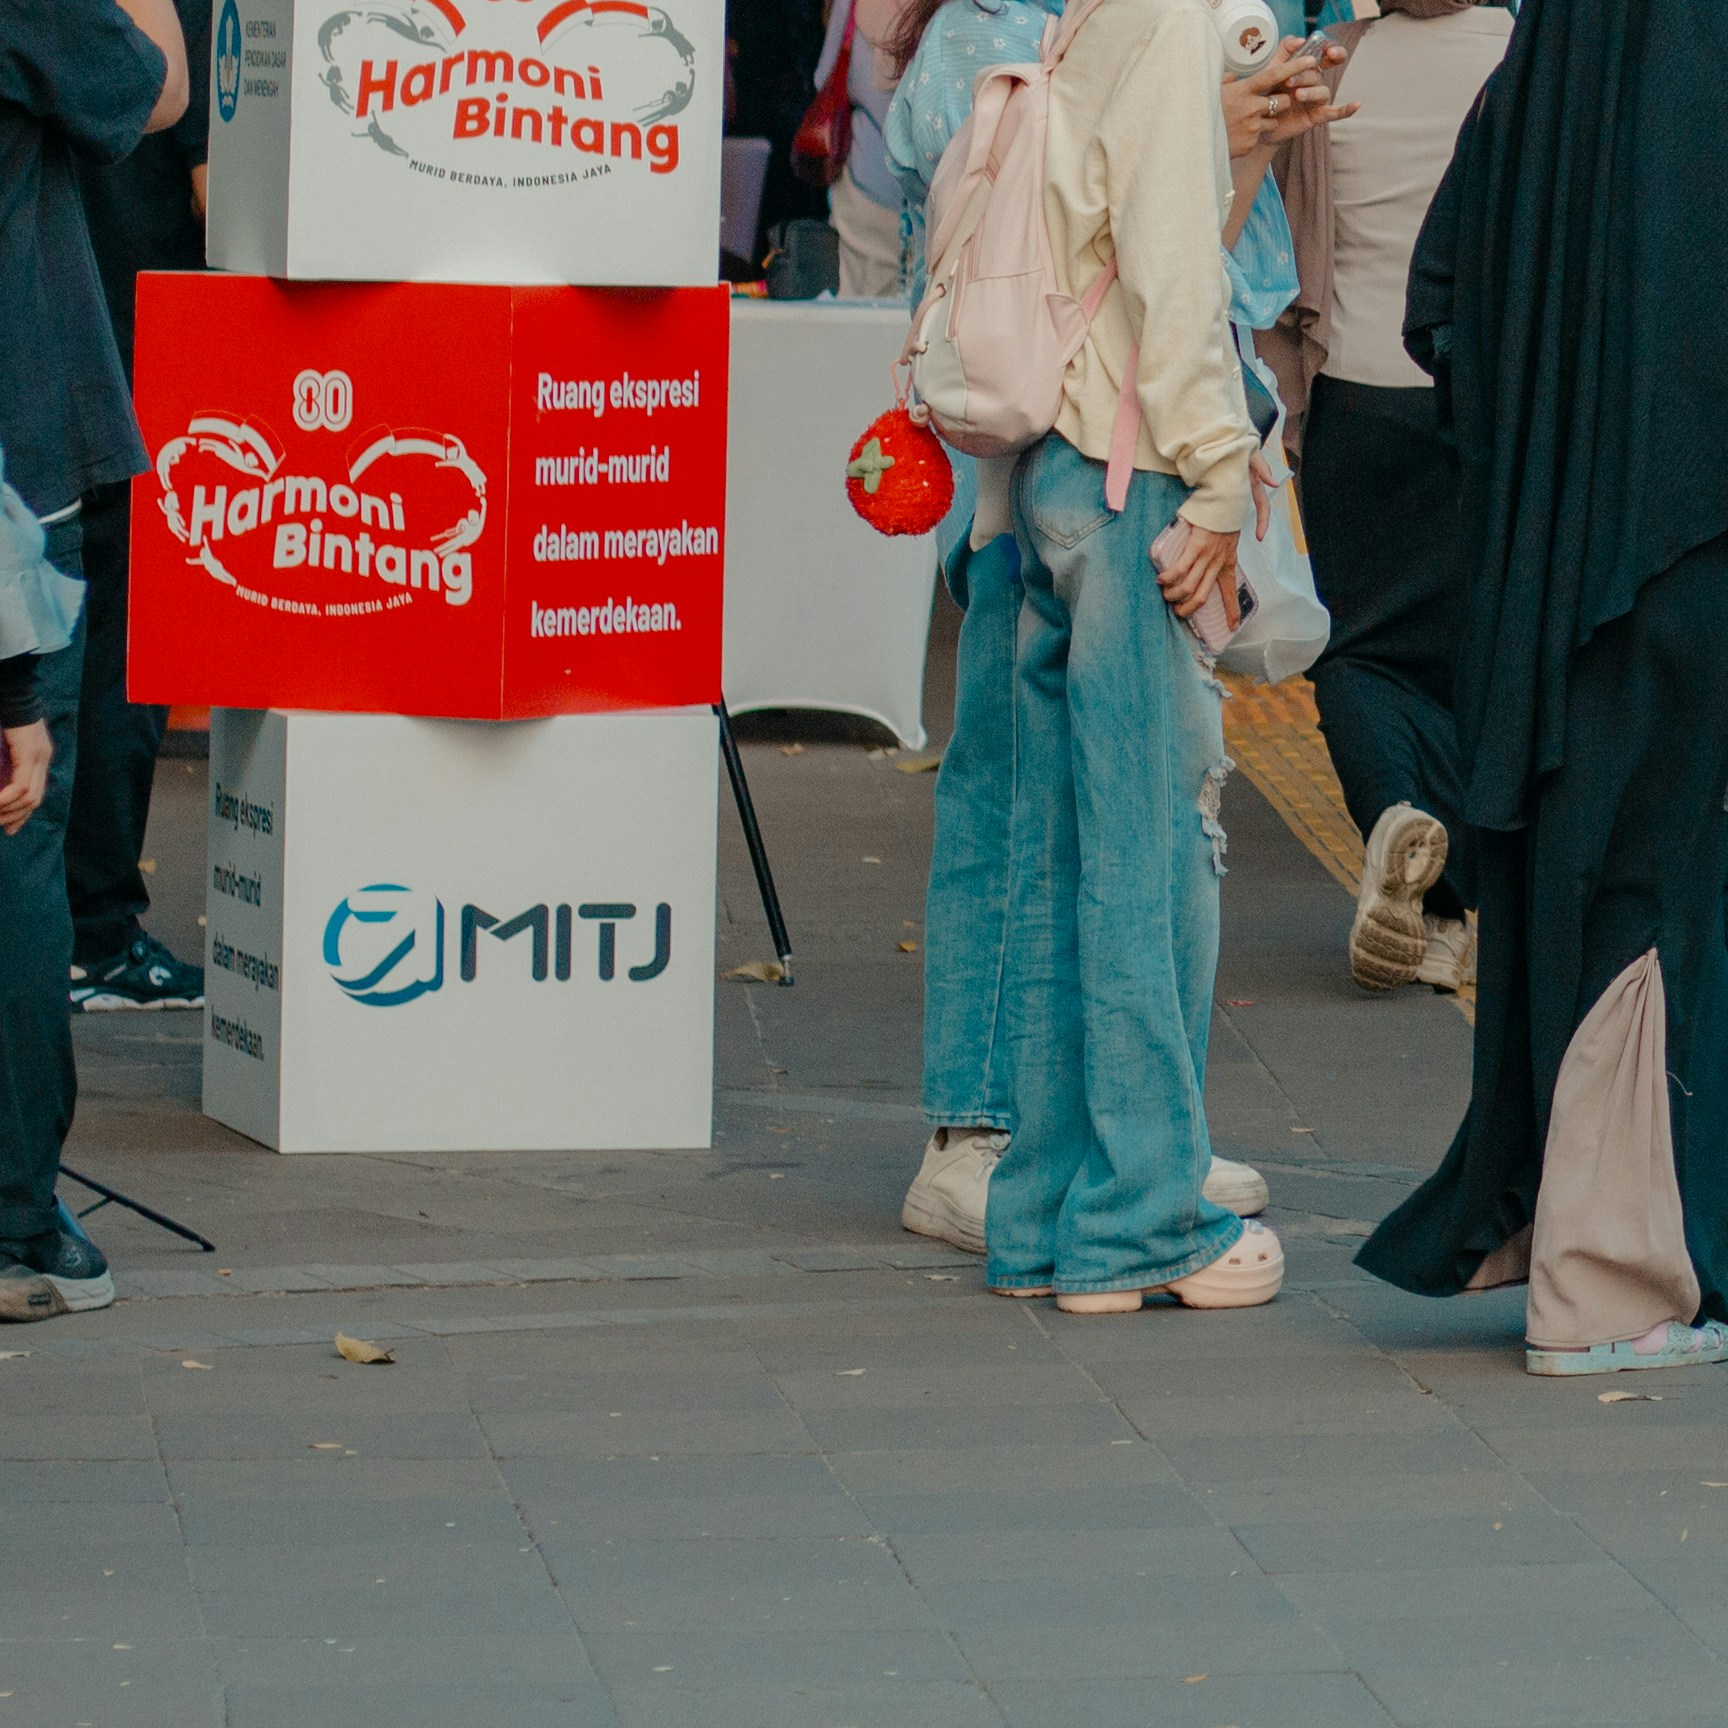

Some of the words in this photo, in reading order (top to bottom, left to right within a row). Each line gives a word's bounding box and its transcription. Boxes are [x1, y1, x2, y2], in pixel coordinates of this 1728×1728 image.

[355, 49, 603, 119] Harmoni
[453, 92, 680, 175] Bintang
[409, 158, 445, 178] MURID
[450, 171, 507, 188] BERDAYA,
[513, 173, 578, 188] INDONESIA
[583, 164, 612, 180] JAYA
[292, 369, 353, 432] 80
[537, 372, 605, 418] Ruang
[610, 369, 700, 417] ekspresi
[535, 444, 670, 486] murid-murid
[189, 475, 405, 546] Harmoni
[273, 519, 472, 606] Bintang
[533, 523, 599, 562] dalam
[604, 519, 719, 566] merayakan
[236, 584, 268, 607] MURID
[325, 598, 383, 616] INDONESIA
[386, 591, 413, 609] JAYA
[530, 595, 682, 638] kemerdekaan.
[215, 782, 239, 831] Ruang
[240, 791, 274, 838] ekspresi
[213, 861, 262, 908] murid-murid
[212, 931, 236, 972] dalam
[236, 952, 279, 992] merayakan
[461, 902, 672, 983] MITJ
